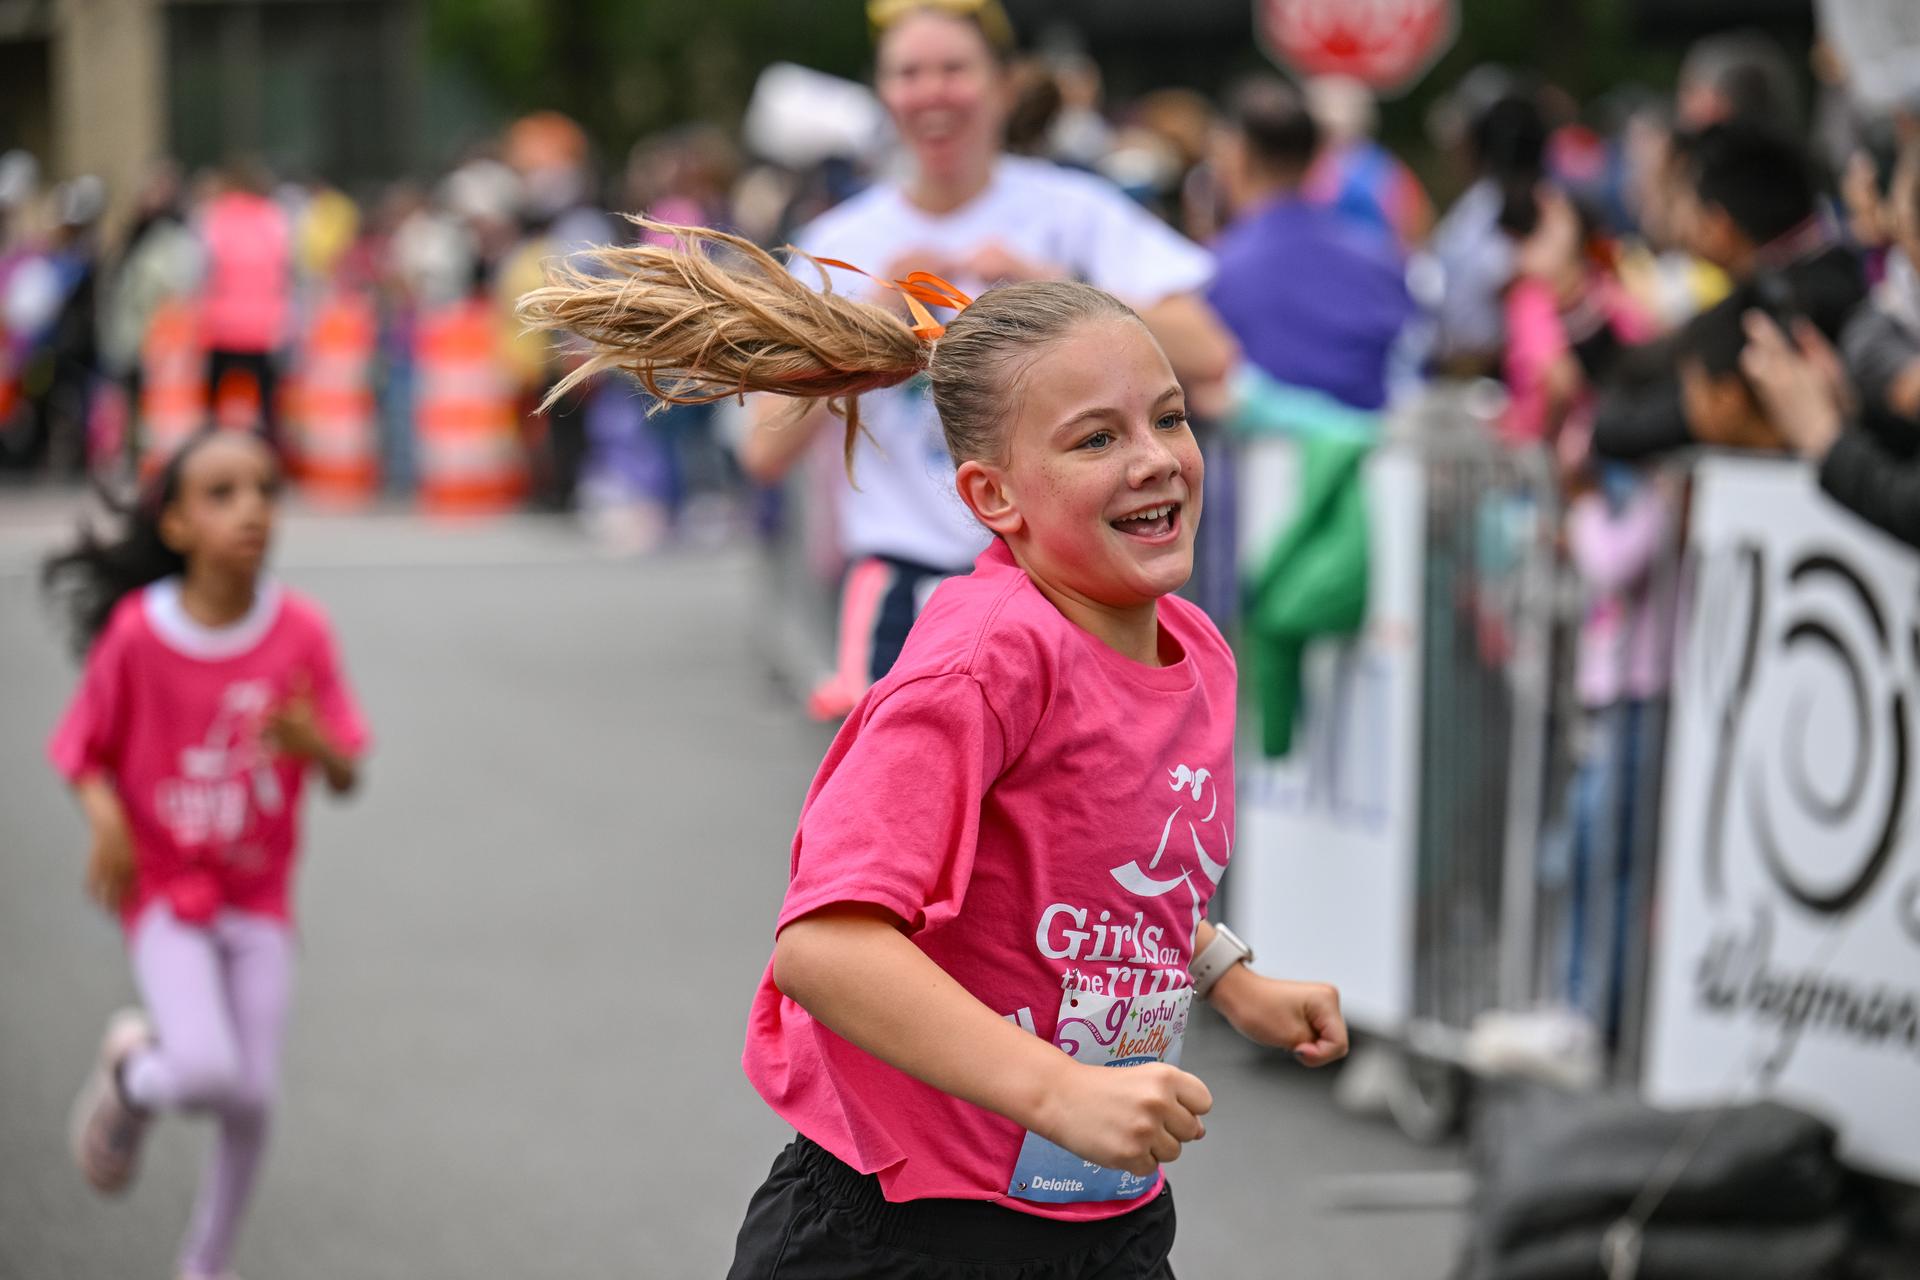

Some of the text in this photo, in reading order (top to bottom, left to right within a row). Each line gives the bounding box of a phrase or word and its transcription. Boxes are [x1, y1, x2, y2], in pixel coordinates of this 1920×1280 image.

[1035, 903, 1180, 965] Girls on
[1060, 966, 1187, 998] the run
[1136, 1000, 1176, 1032] joyful
[1115, 1023, 1172, 1059] healthy
[1031, 1175, 1085, 1192] Deloitte.
